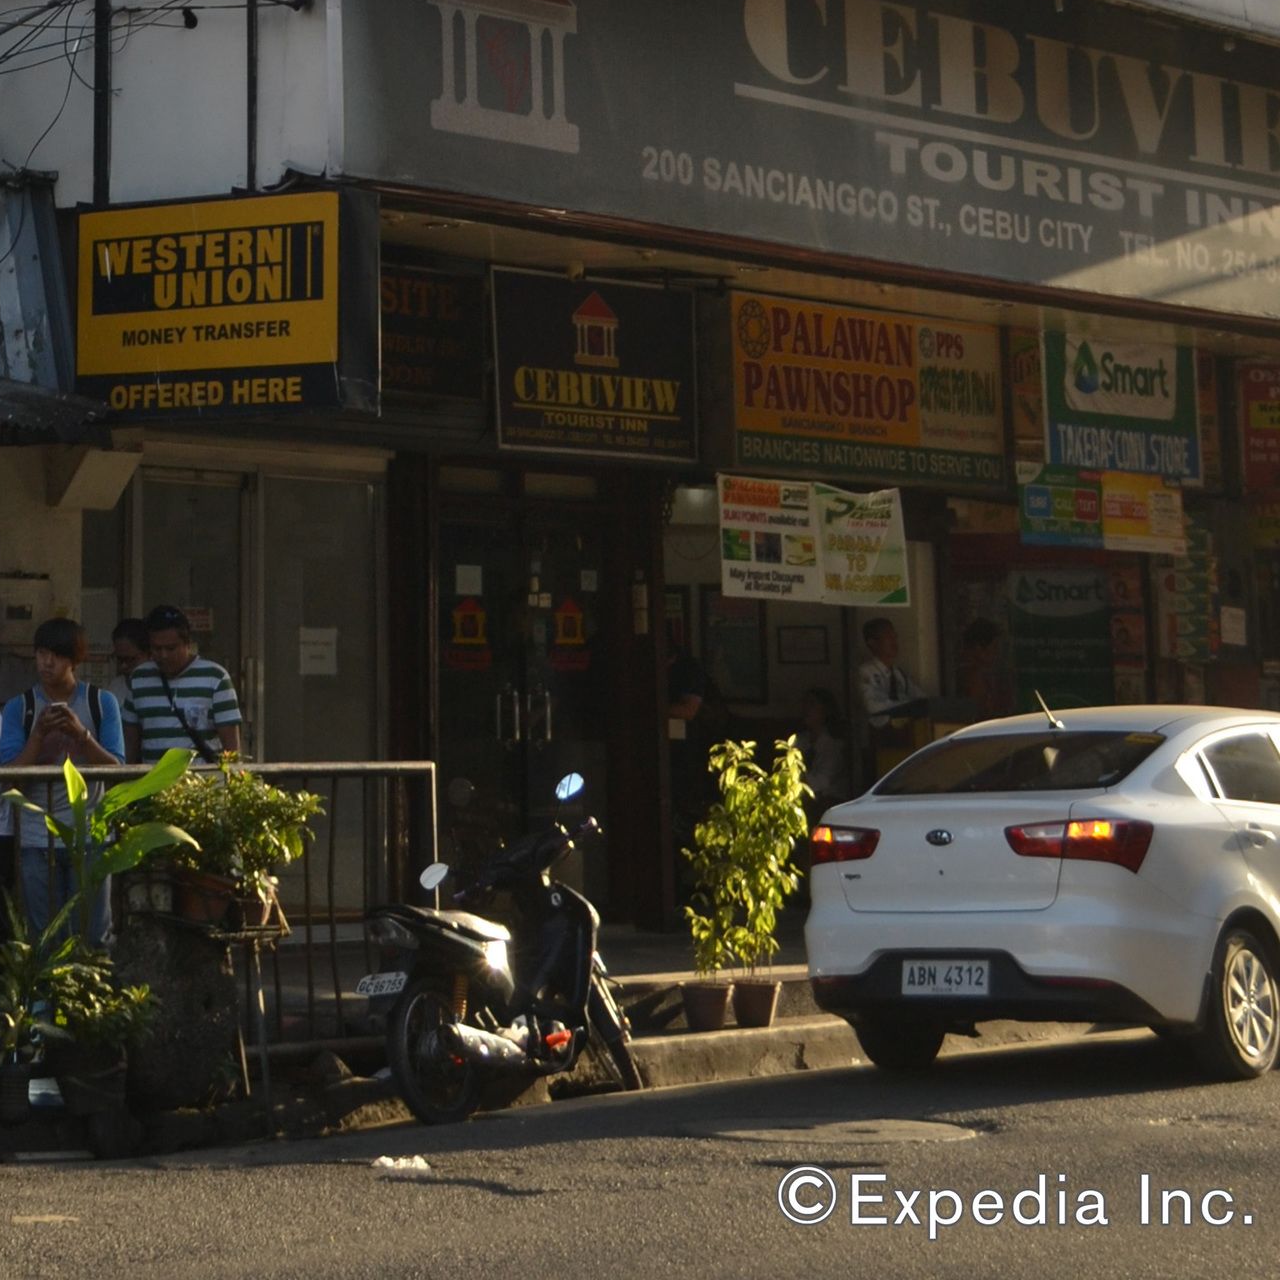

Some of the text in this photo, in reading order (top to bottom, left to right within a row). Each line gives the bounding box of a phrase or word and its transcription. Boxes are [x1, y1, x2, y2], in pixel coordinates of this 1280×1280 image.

[875, 131, 1280, 240] TOURIST INN
[640, 145, 694, 188] 200
[702, 155, 899, 225] SANCIANGCO
[907, 194, 952, 237] ST.,
[959, 204, 1031, 245] CEBU
[1039, 217, 1093, 254] CITY
[1117, 229, 1170, 267] TEL.
[1176, 238, 1217, 275] NO.
[97, 227, 283, 277] WESTERN
[154, 263, 283, 309] UNION
[121, 320, 290, 347] MONEY TRANSFER
[771, 306, 965, 368] PALAWAN PPS
[110, 375, 302, 411] OFFERED HERE
[513, 365, 681, 414] CEBUVIEW
[743, 361, 916, 423] PAWNSHOP
[1101, 351, 1169, 398] Smart
[544, 410, 648, 433] TOURIST INN
[742, 436, 1002, 480] BRANCHES NATIONWIDE TO SERVE YOU
[1034, 580, 1105, 602] Smart
[907, 965, 985, 986] ABN 4312
